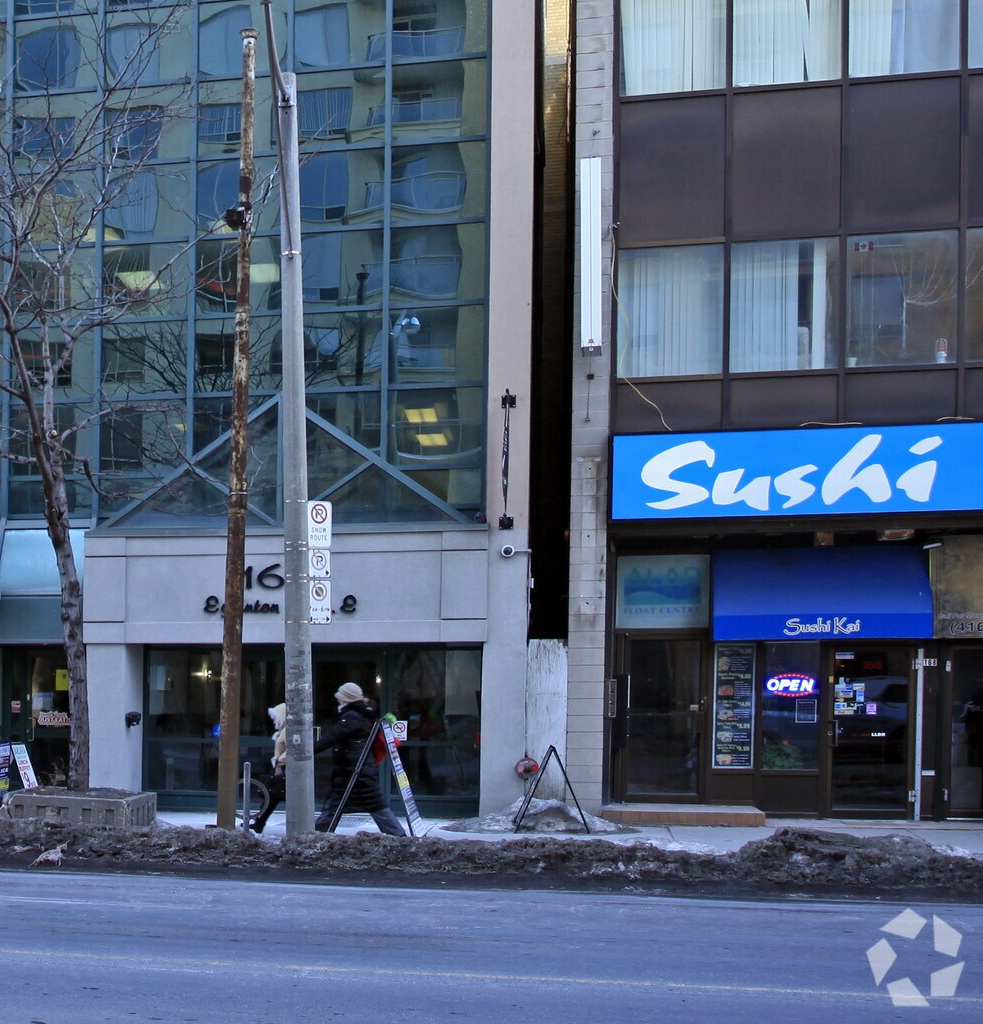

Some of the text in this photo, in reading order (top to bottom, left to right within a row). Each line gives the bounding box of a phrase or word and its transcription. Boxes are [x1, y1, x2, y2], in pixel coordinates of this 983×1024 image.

[641, 434, 943, 511] Sushi
[624, 607, 656, 615] FLOAT
[783, 617, 860, 635] Sushi Kai
[767, 678, 815, 691] OPEN
